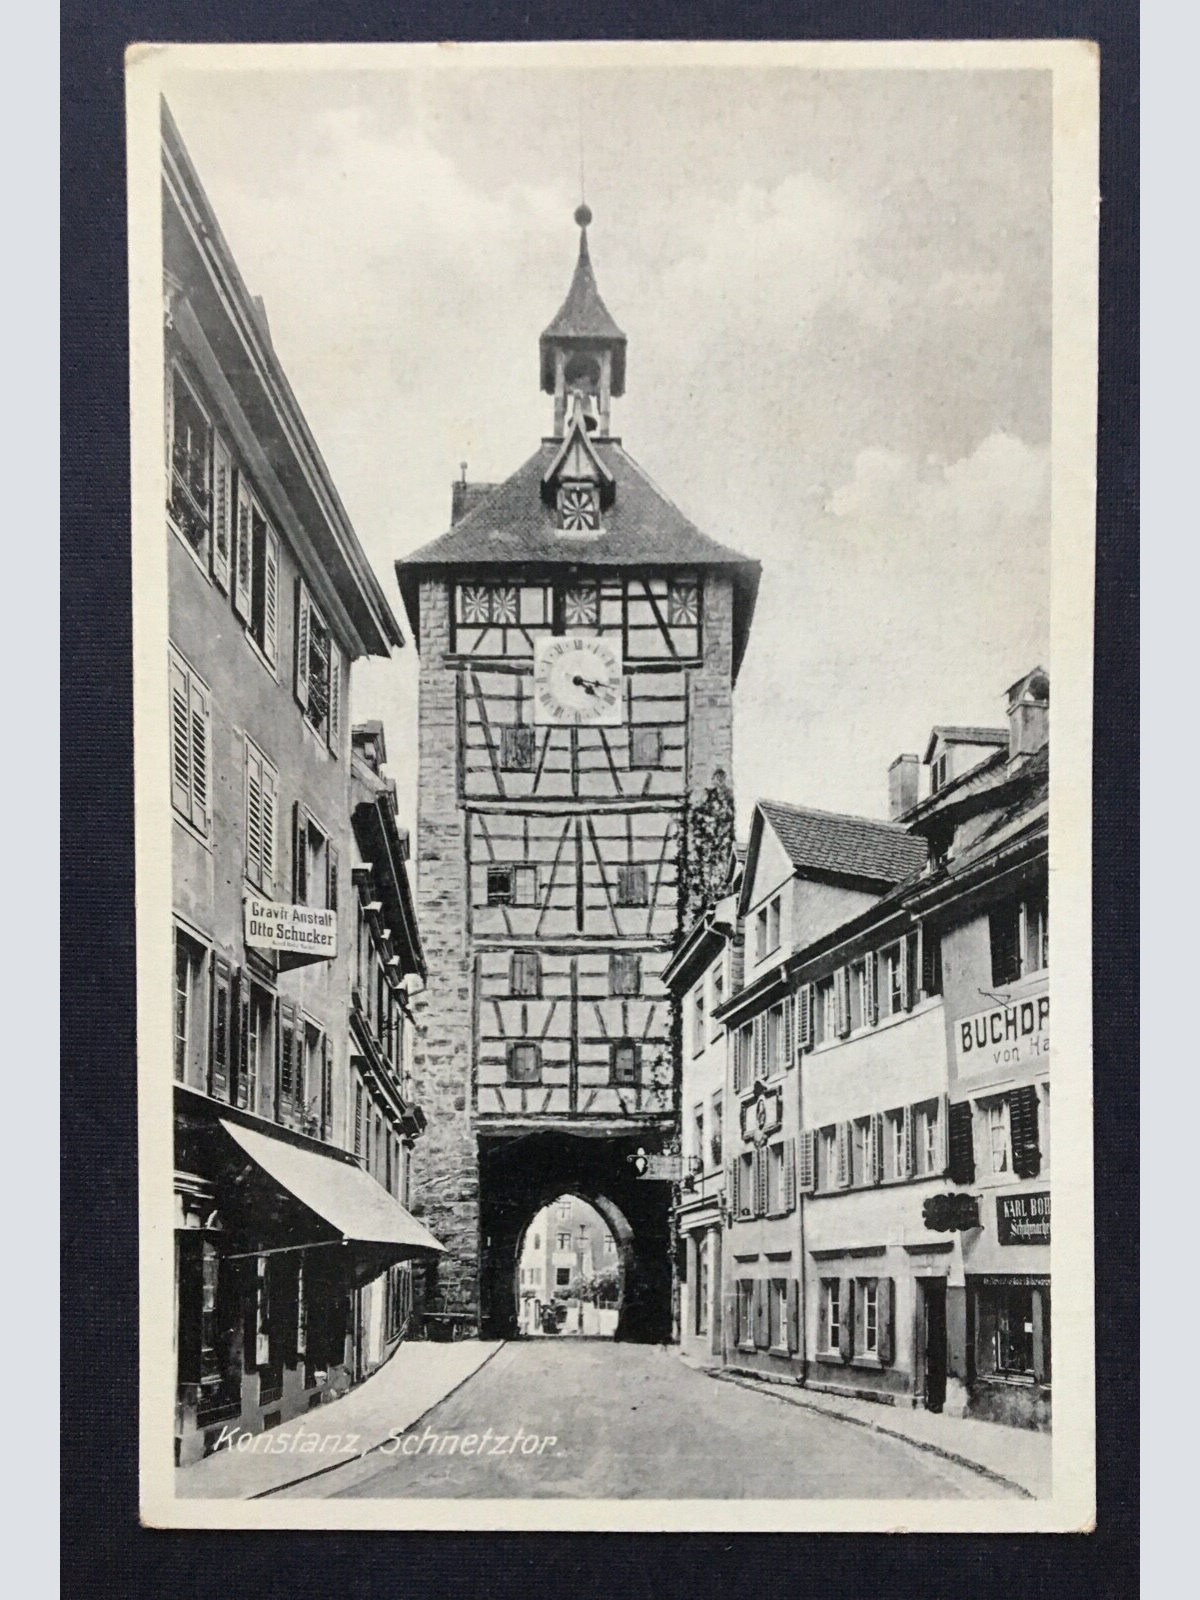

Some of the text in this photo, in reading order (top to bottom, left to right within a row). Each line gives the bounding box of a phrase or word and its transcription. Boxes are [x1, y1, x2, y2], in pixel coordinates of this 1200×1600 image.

[292, 909, 333, 927] Anstalt
[249, 920, 334, 945] Otto Schucker
[993, 1047, 1020, 1064] von
[1003, 1199, 1028, 1218] KARL
